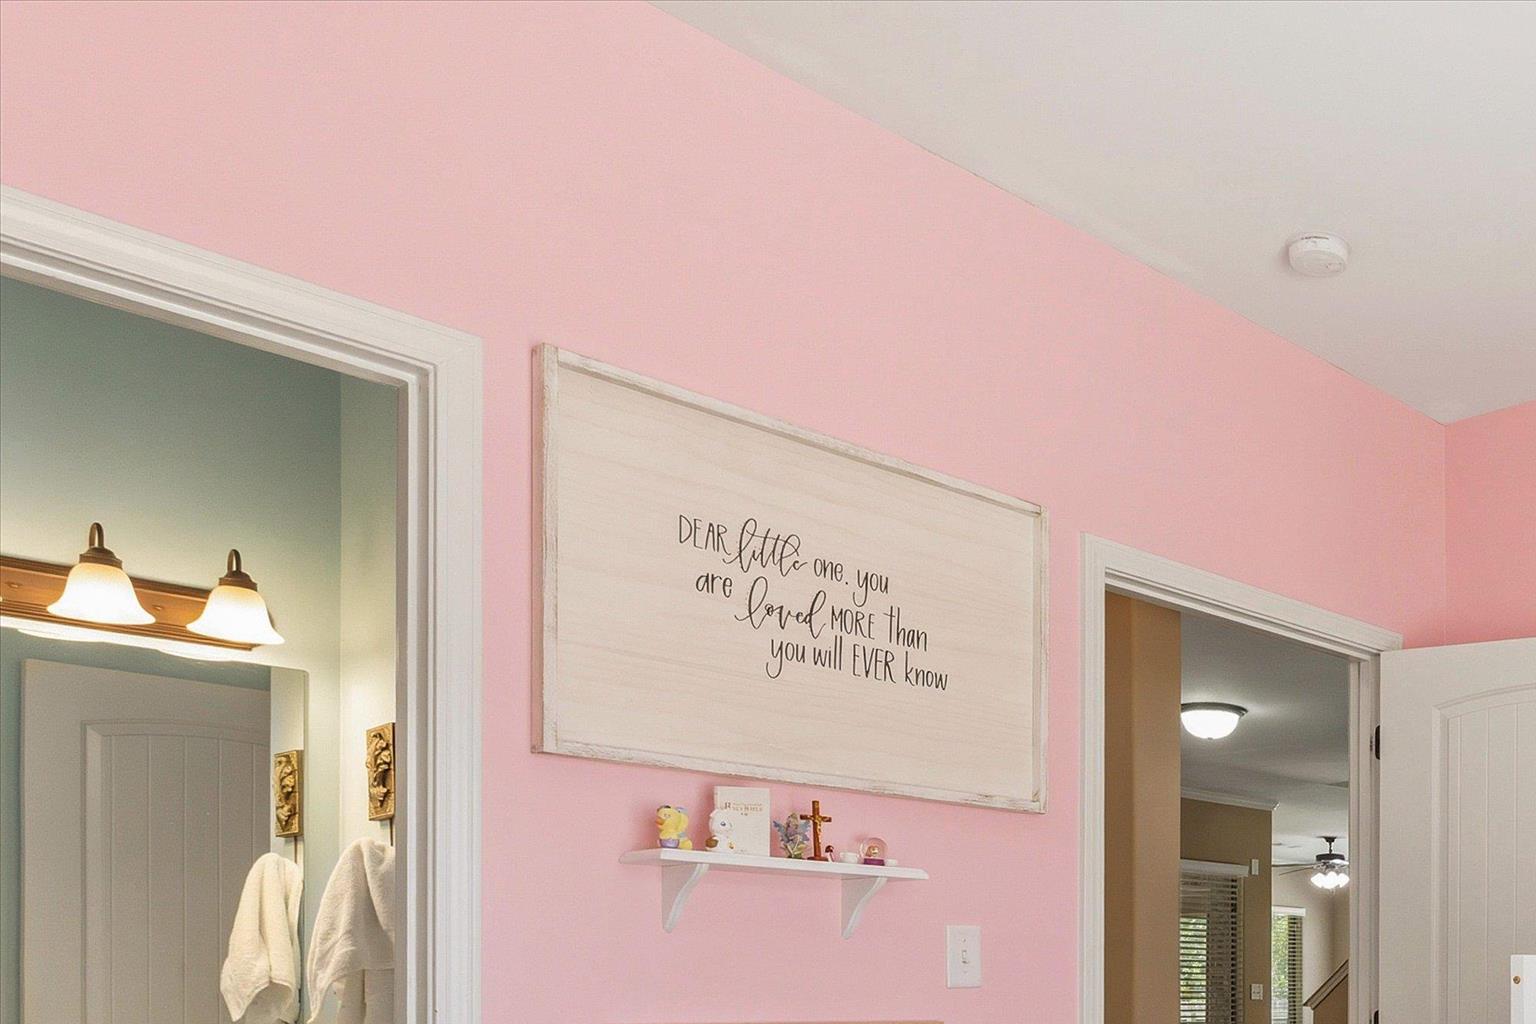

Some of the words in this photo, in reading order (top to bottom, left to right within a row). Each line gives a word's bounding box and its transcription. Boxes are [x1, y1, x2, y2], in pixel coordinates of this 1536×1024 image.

[678, 513, 732, 556] DEAR
[722, 517, 809, 578] little
[852, 568, 890, 608] you
[695, 572, 733, 599] are
[733, 575, 827, 640] loved
[830, 604, 876, 641] MORE
[882, 605, 928, 653] than
[765, 638, 806, 680] you
[812, 635, 843, 672] will
[852, 643, 897, 685] EVER
[904, 650, 949, 691] know
